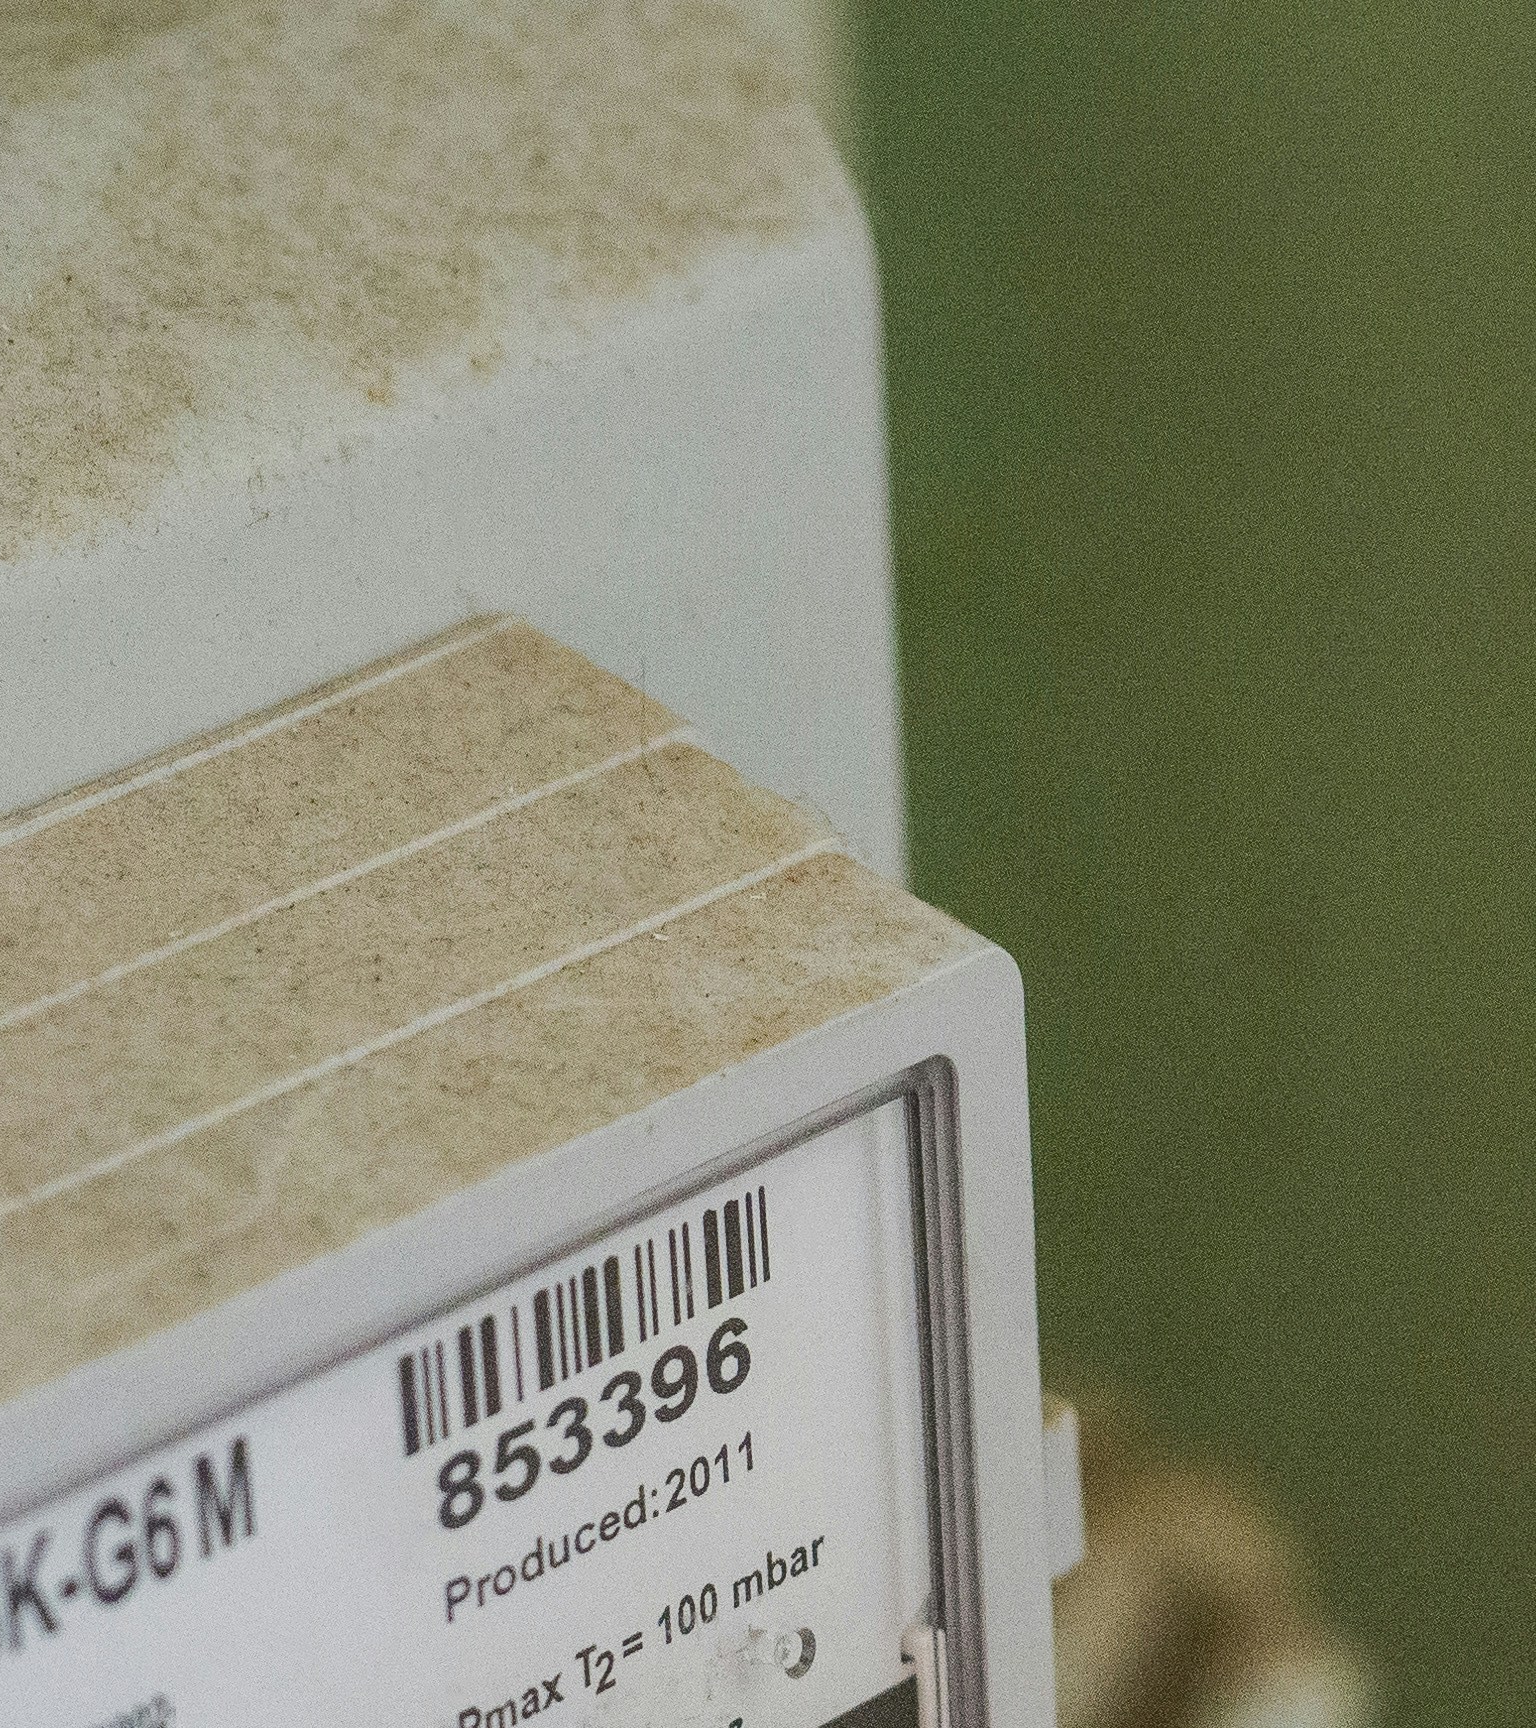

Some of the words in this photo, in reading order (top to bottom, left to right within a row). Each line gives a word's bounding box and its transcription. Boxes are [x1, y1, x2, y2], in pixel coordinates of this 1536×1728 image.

[436, 1316, 752, 1530] 853396
[657, 1582, 719, 1645] 100
[732, 1534, 826, 1608] mbar
